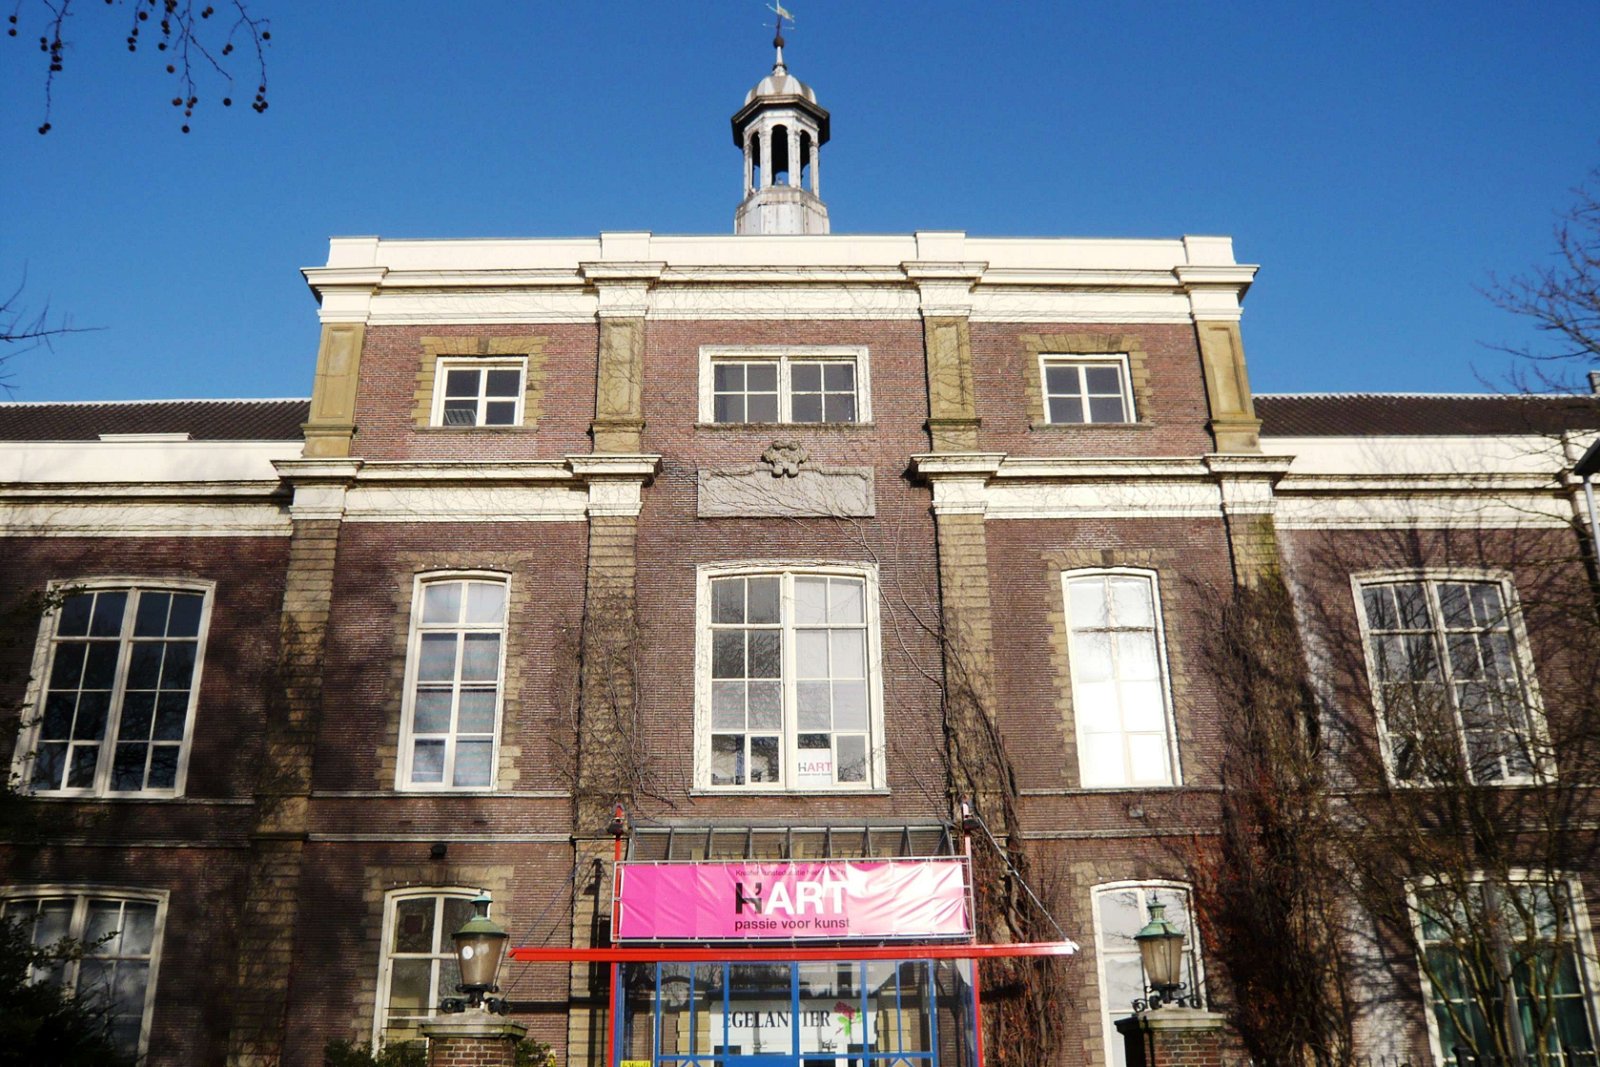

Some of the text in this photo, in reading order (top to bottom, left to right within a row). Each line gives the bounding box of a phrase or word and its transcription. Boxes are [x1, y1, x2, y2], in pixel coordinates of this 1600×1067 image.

[735, 917, 849, 931] passie voor kunst
